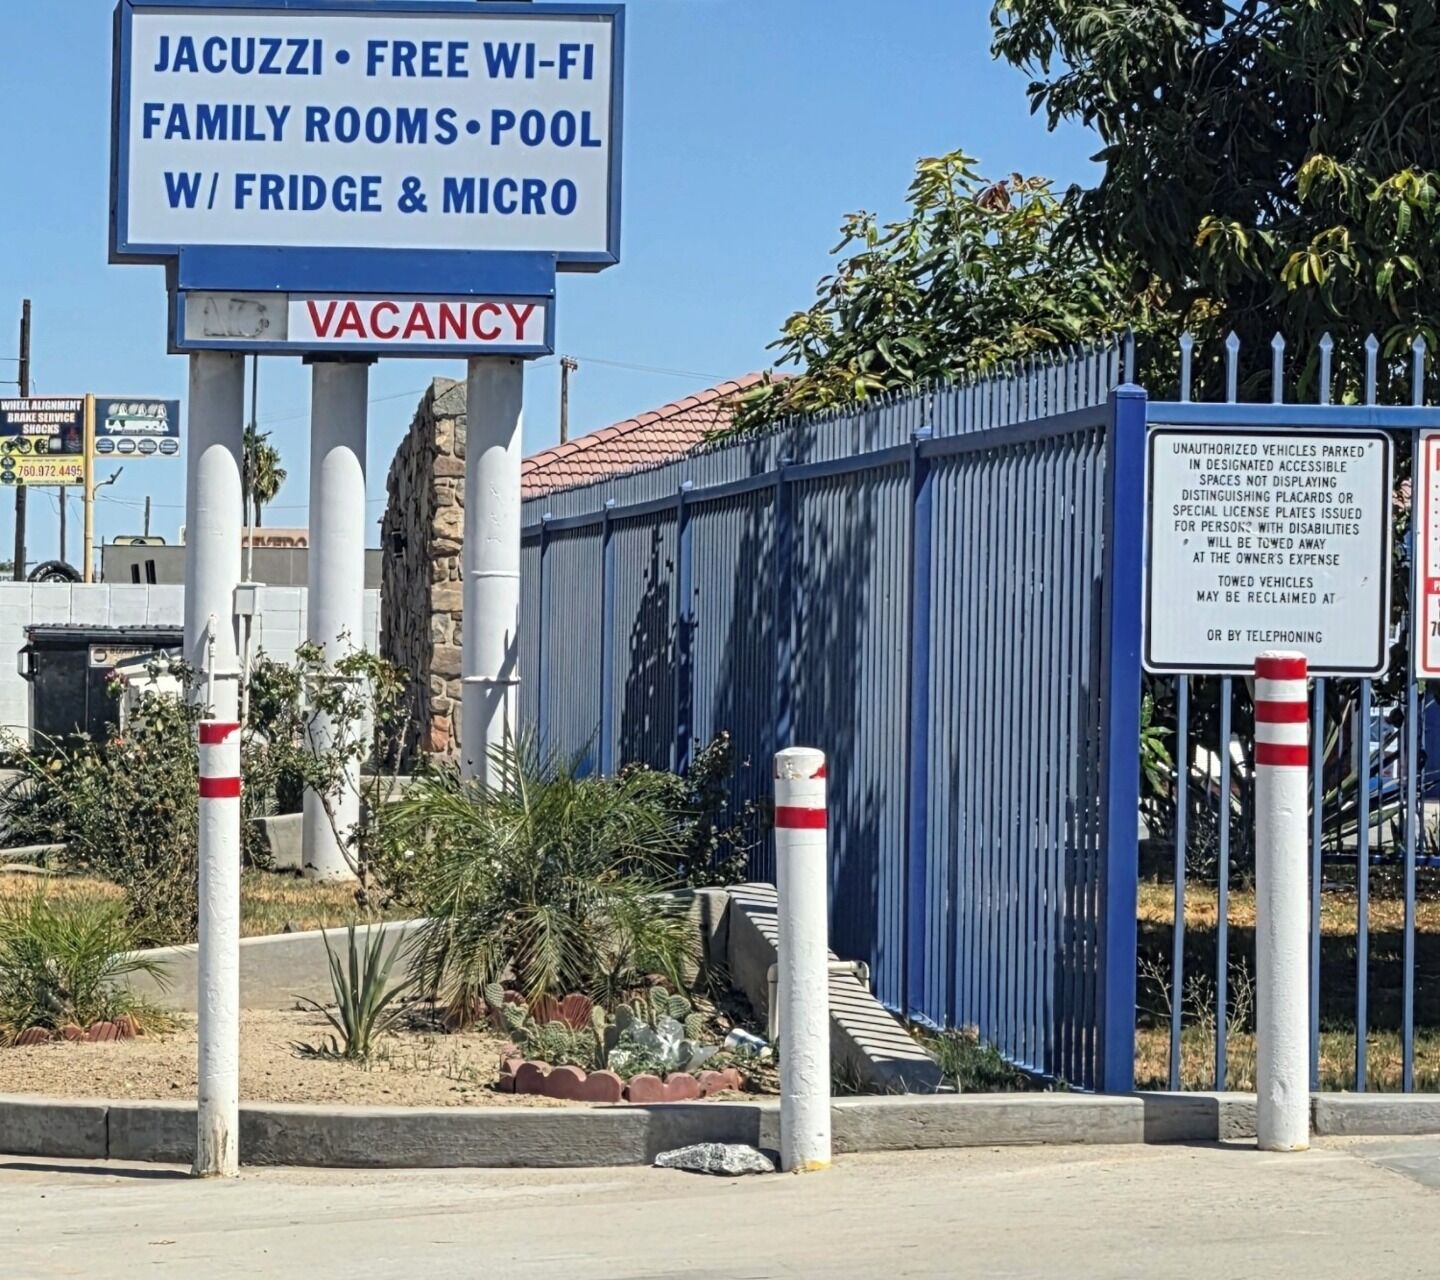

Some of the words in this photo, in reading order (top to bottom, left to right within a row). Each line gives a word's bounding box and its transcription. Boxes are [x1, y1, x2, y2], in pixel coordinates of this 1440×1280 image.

[154, 36, 322, 75] JACUZZI
[367, 40, 468, 78] FREE
[483, 42, 593, 80] WI-FI
[143, 103, 291, 141] FAMILY
[306, 106, 458, 145] ROOMS
[491, 109, 601, 147] POOL
[164, 172, 219, 209] W/
[235, 173, 382, 212] FRIDGE
[398, 176, 427, 213] &
[443, 177, 577, 215] MICRO
[306, 300, 536, 340] VACANCY
[1, 401, 30, 410] WHEEL
[31, 401, 81, 410] ALIGNMENT
[8, 413, 36, 422] BRAKE
[38, 413, 75, 422] SERVICE
[23, 424, 59, 434] SHOCKS
[1174, 443, 1257, 455] UNAUTHORIZED
[1263, 445, 1316, 456] VEHICLES
[1323, 446, 1364, 457] PARKED
[1190, 459, 1200, 469] IN
[1207, 459, 1273, 471] DESIGNATED
[1279, 460, 1346, 472] ACCESSIBLE
[1200, 474, 1240, 486] SPACES
[1247, 476, 1267, 486] NOT
[1273, 476, 1336, 488] DISPLAYING
[1183, 490, 1270, 502] DISTINGUISHING
[1276, 492, 1332, 503] PLACARDS
[1339, 492, 1353, 504] OR
[1173, 505, 1217, 516] SPECIAL
[1224, 506, 1269, 517] LICENSE
[1276, 507, 1315, 518] PLATES
[1322, 508, 1361, 519] ISSUED
[1175, 521, 1195, 531] FOR
[1259, 522, 1283, 533] WITH
[1290, 523, 1359, 535] DISABILITIES
[1208, 537, 1232, 548] WILL
[1238, 537, 1251, 548] BE
[1258, 537, 1293, 549] TOWED
[1299, 539, 1325, 549] AWAY
[1193, 552, 1204, 562] AT
[1211, 552, 1230, 563] THE
[1237, 553, 1283, 564] OWNER'S
[1290, 554, 1339, 565] EXPENSE
[1219, 576, 1254, 587] TOWED
[1260, 576, 1313, 588] VEHICLES
[1197, 591, 1218, 601] MAY
[1226, 592, 1240, 602] BE
[1248, 592, 1316, 604] RECLAIMED
[1323, 593, 1334, 603] AT
[1208, 629, 1221, 640] OR
[1228, 630, 1241, 641] BY
[1247, 630, 1322, 643] TELEPHONING
